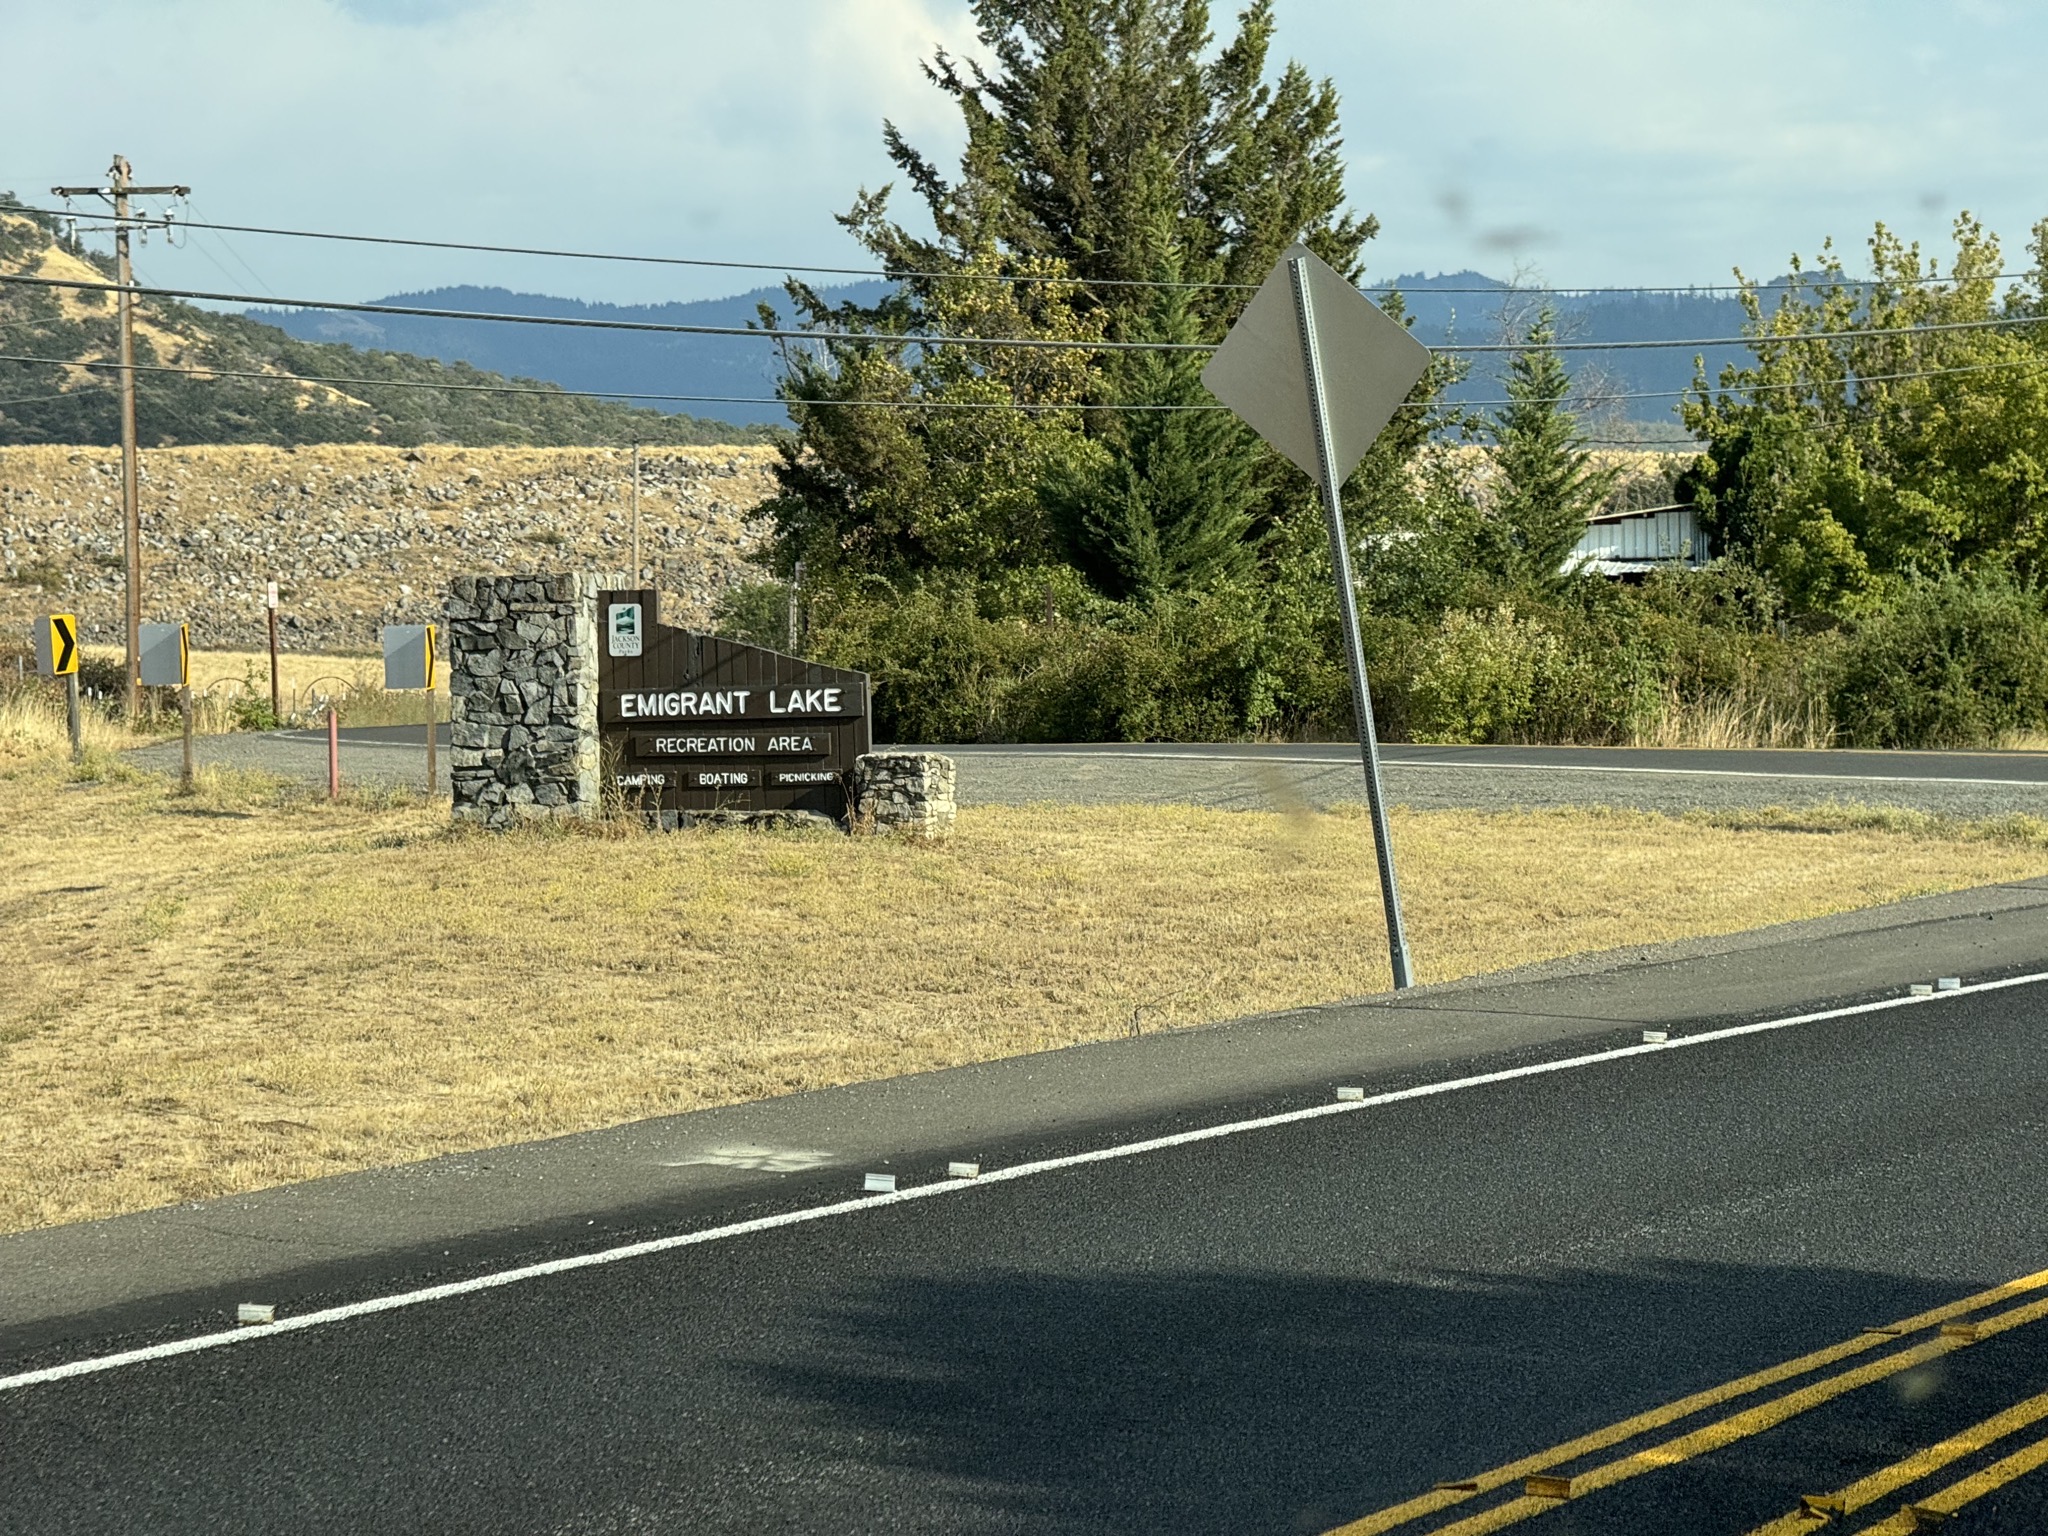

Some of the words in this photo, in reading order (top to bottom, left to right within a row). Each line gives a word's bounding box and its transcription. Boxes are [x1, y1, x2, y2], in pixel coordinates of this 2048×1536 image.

[611, 635, 640, 643] JACKSON
[612, 642, 639, 650] COUNTY
[620, 691, 751, 717] EMIGRANT
[769, 688, 842, 713] LAKE
[656, 737, 755, 753] RECREATION
[767, 737, 813, 751] AREA
[616, 774, 665, 786] CAMPING
[699, 773, 748, 785] BOATING
[779, 772, 834, 782] PICNICKING
